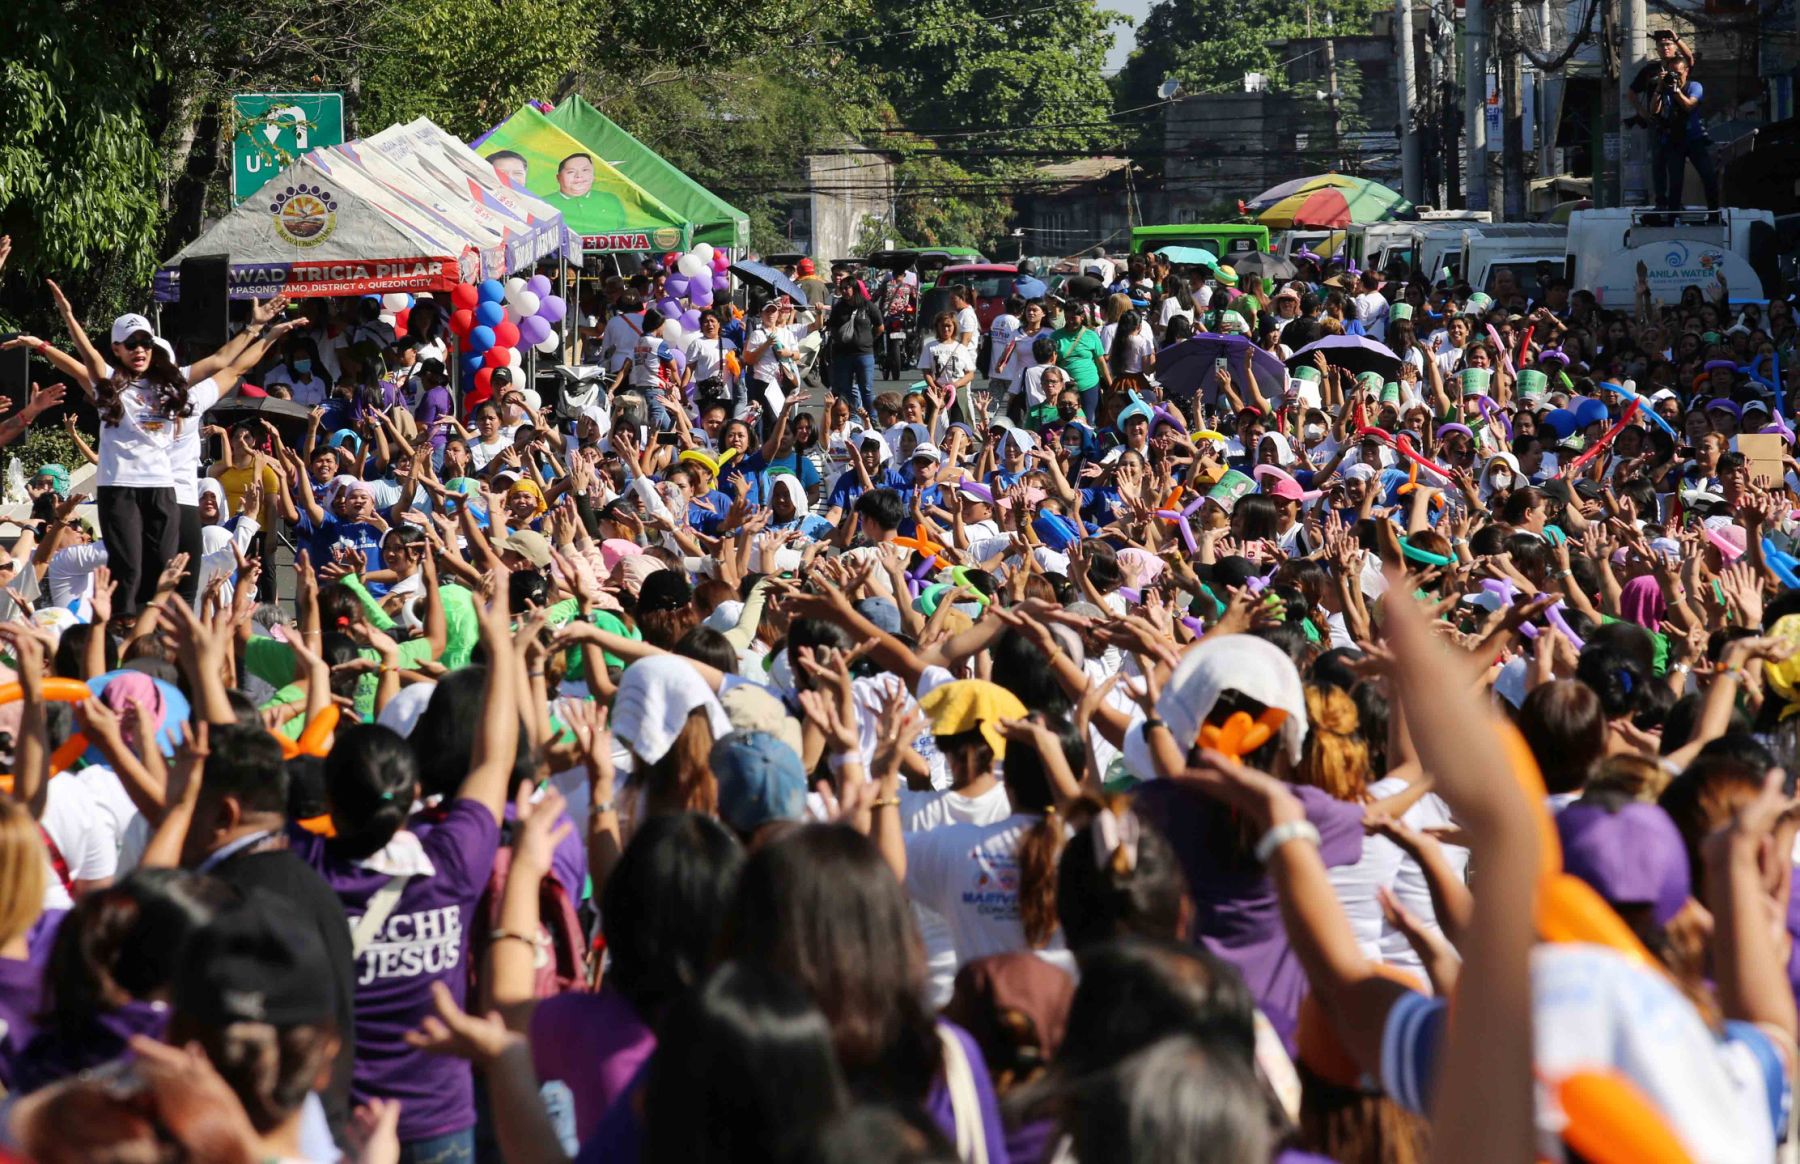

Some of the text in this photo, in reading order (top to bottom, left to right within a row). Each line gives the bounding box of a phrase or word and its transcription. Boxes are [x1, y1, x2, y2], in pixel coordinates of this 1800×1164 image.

[582, 234, 651, 250] EDINA
[292, 263, 371, 283] TRICIA
[376, 261, 443, 279] PILAR
[1649, 269, 1715, 278] ANILA WATER
[236, 285, 277, 294] PASONG
[281, 284, 310, 294] TAMO,
[312, 282, 356, 292] DISTRICT
[368, 280, 408, 290] QUEZON
[409, 278, 433, 288] CITY
[358, 940, 461, 985] JESUS
